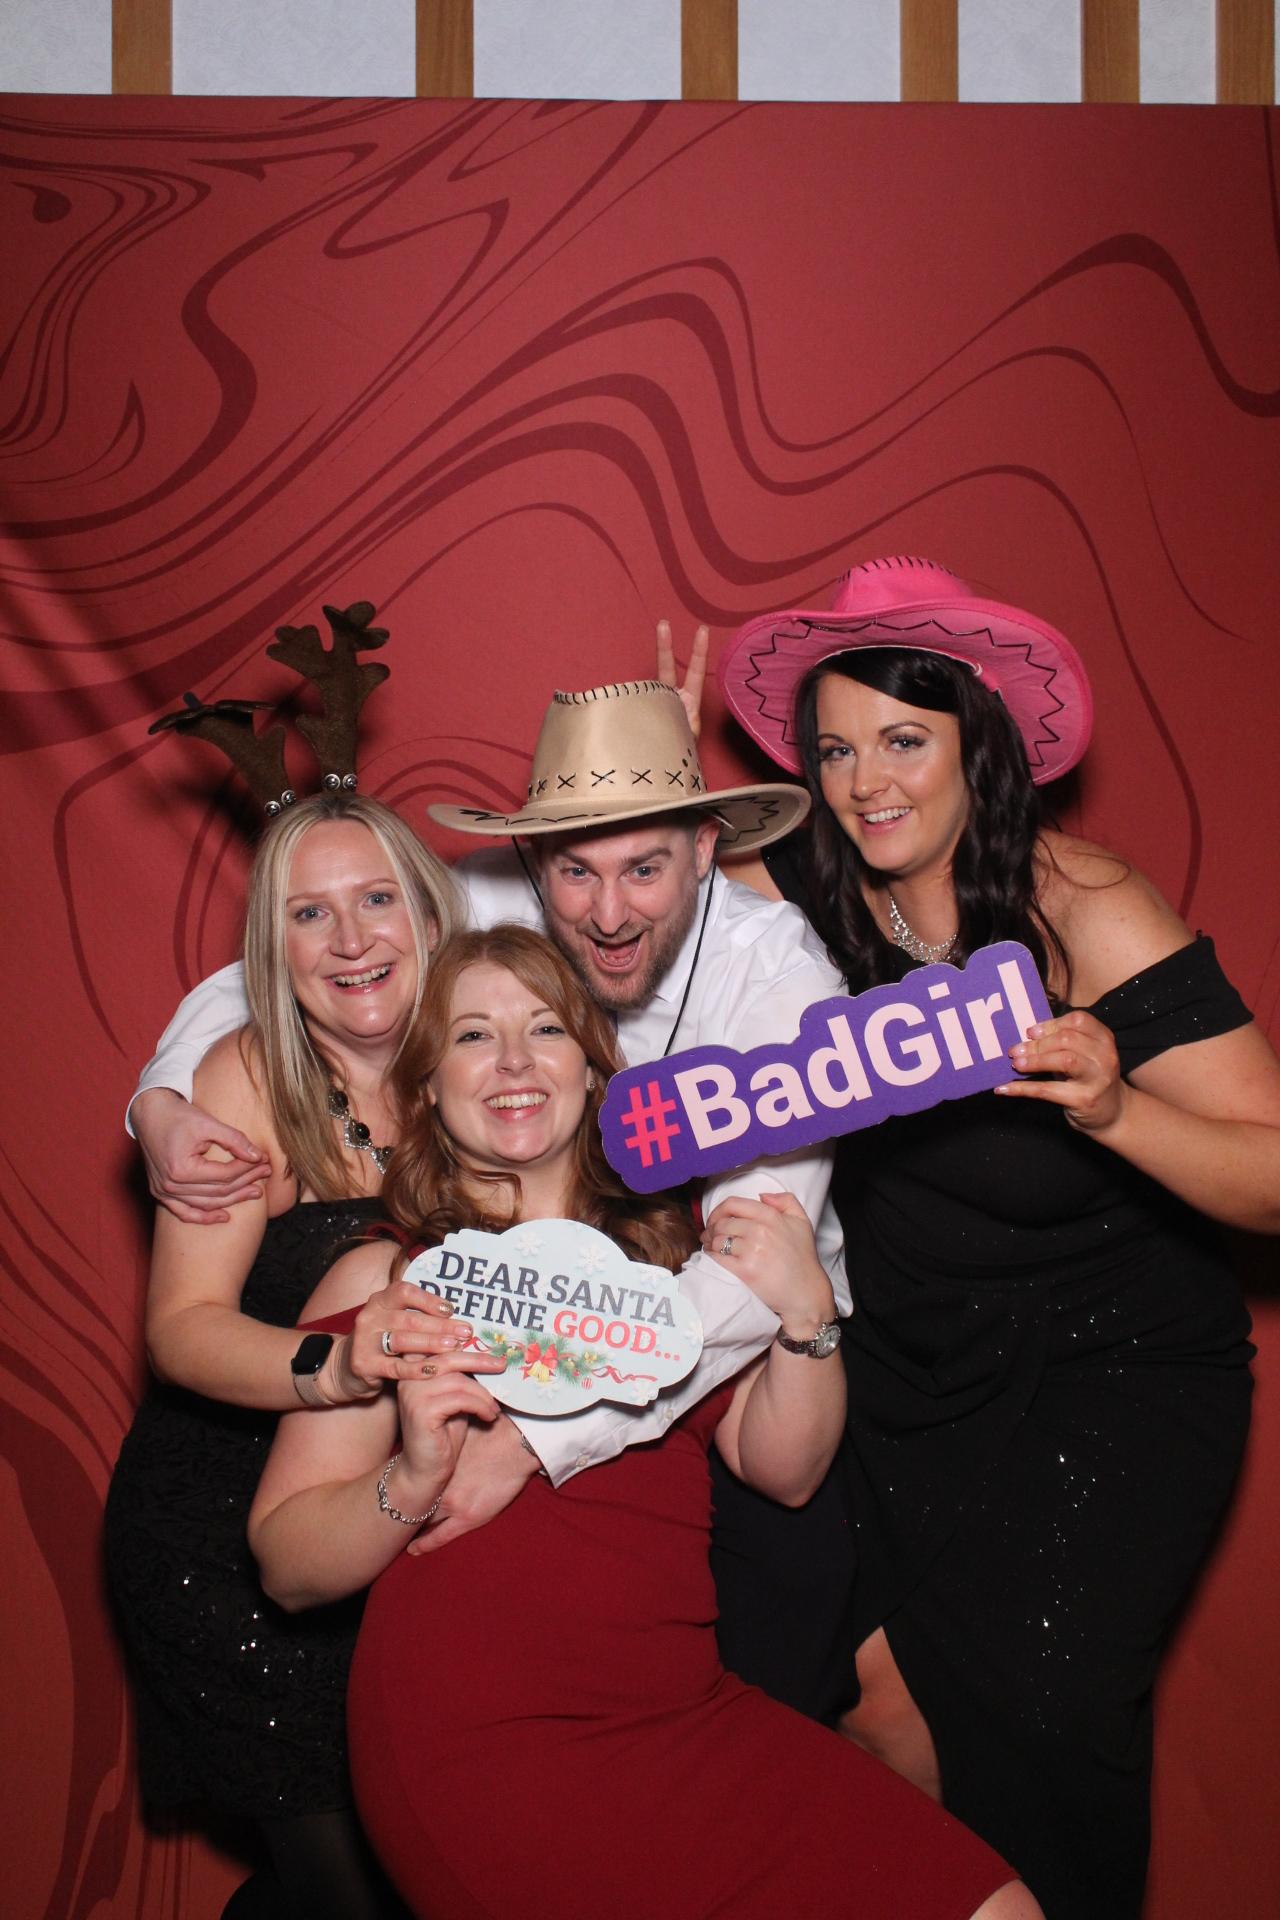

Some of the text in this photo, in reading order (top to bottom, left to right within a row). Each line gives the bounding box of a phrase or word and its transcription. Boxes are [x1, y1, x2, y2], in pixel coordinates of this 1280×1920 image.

[620, 960, 1036, 1168] #BadGirl
[436, 1251, 675, 1326] DEAR SANTA
[553, 1310, 680, 1360] GOOD...
